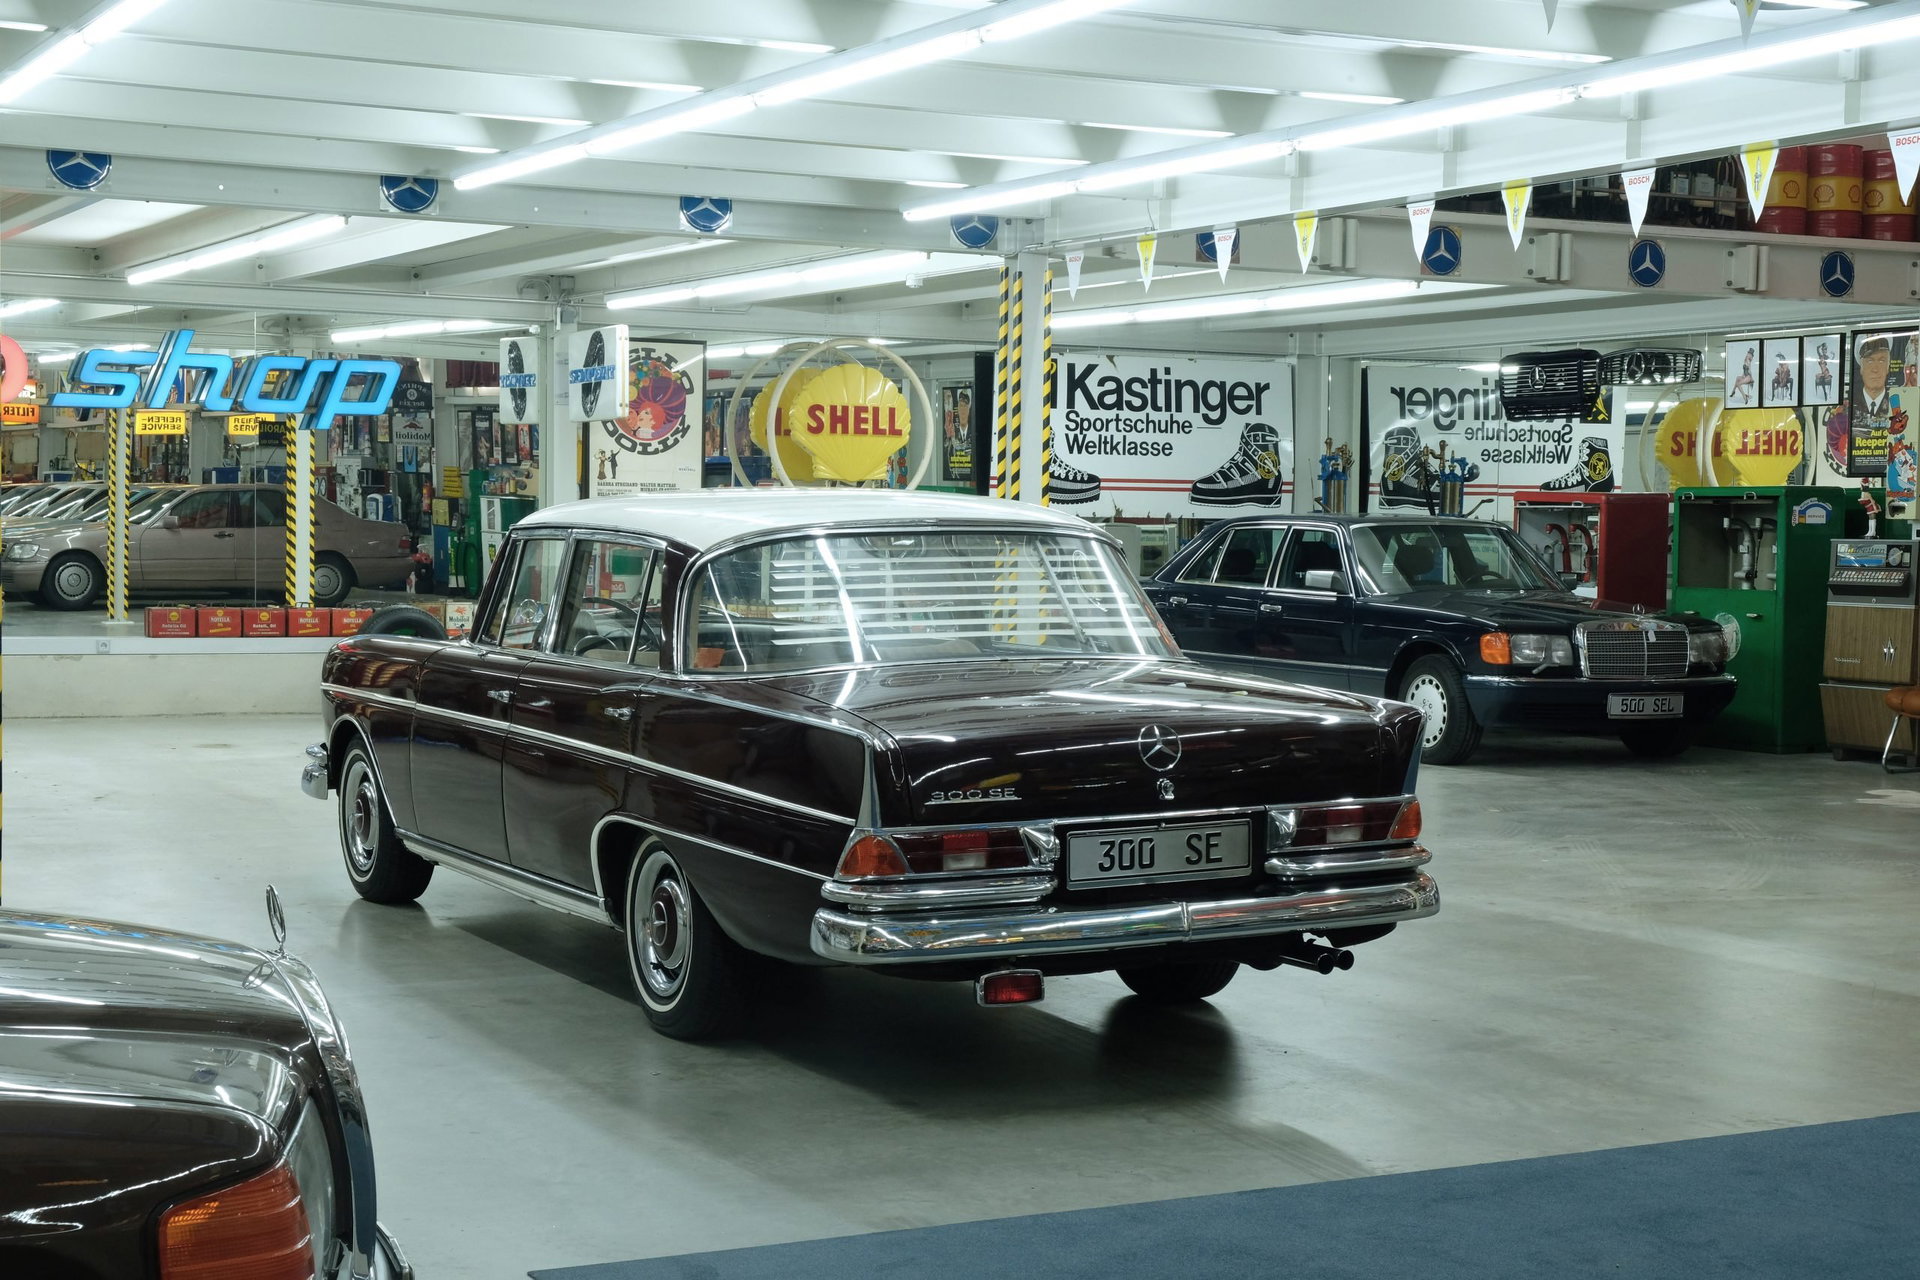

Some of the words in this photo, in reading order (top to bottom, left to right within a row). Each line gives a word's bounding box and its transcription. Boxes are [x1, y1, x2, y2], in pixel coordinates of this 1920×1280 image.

[1628, 175, 1650, 185] BOSCH
[1412, 207, 1430, 216] BOSCH
[1066, 362, 1270, 426] Kastinger
[806, 403, 903, 436] SHELL
[1065, 409, 1193, 435] Sportschuhe
[601, 414, 691, 456] DOLLY
[1065, 433, 1174, 457] Weltklasse
[1855, 437, 1887, 449] Reeper
[1620, 698, 1645, 713] 500
[1652, 697, 1674, 713] SEL
[931, 789, 982, 801] 300
[989, 788, 1015, 799] SE
[1098, 837, 1155, 872] 300
[1185, 832, 1222, 865] SE
